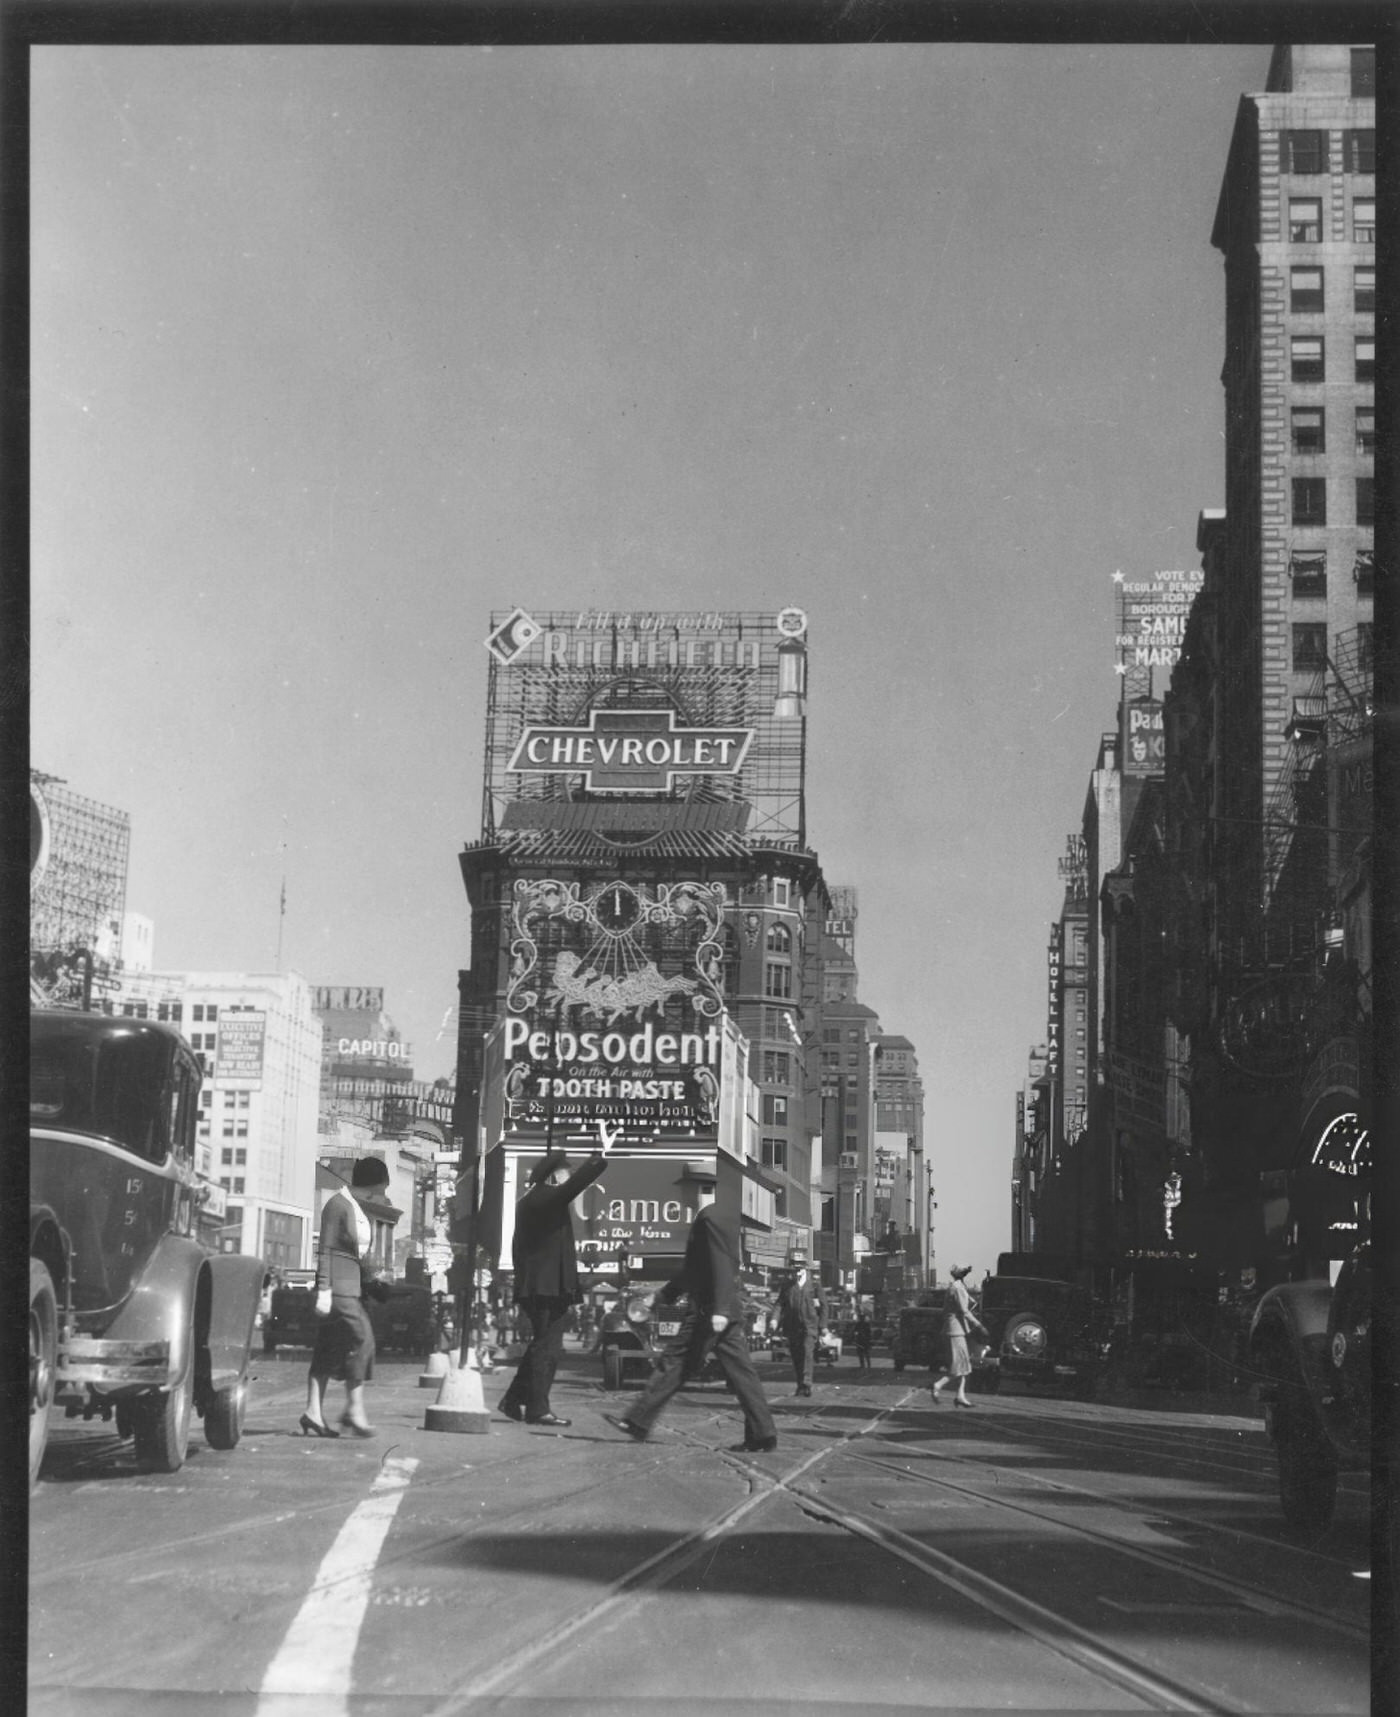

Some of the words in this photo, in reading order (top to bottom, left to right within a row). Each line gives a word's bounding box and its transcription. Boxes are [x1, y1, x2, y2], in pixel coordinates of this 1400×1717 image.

[1154, 570, 1185, 581] VOTE
[1122, 582, 1164, 592] REGULAR
[1162, 593, 1185, 602] FOR
[1131, 604, 1190, 614] BOROUGH
[1115, 635, 1133, 645] FOR
[543, 632, 760, 669] RICHFIELD
[527, 737, 737, 765] CHEVROLET
[1049, 952, 1059, 1015] HOTEL
[338, 1038, 410, 1058] CAPITOL
[504, 1018, 720, 1068] Pepsodent
[1049, 1023, 1059, 1074] TAFT
[569, 1065, 585, 1077] On
[588, 1066, 607, 1077] the
[610, 1066, 628, 1077] Air
[631, 1067, 654, 1078] with
[536, 1077, 611, 1098] TOOTH
[619, 1079, 686, 1100] PASTE
